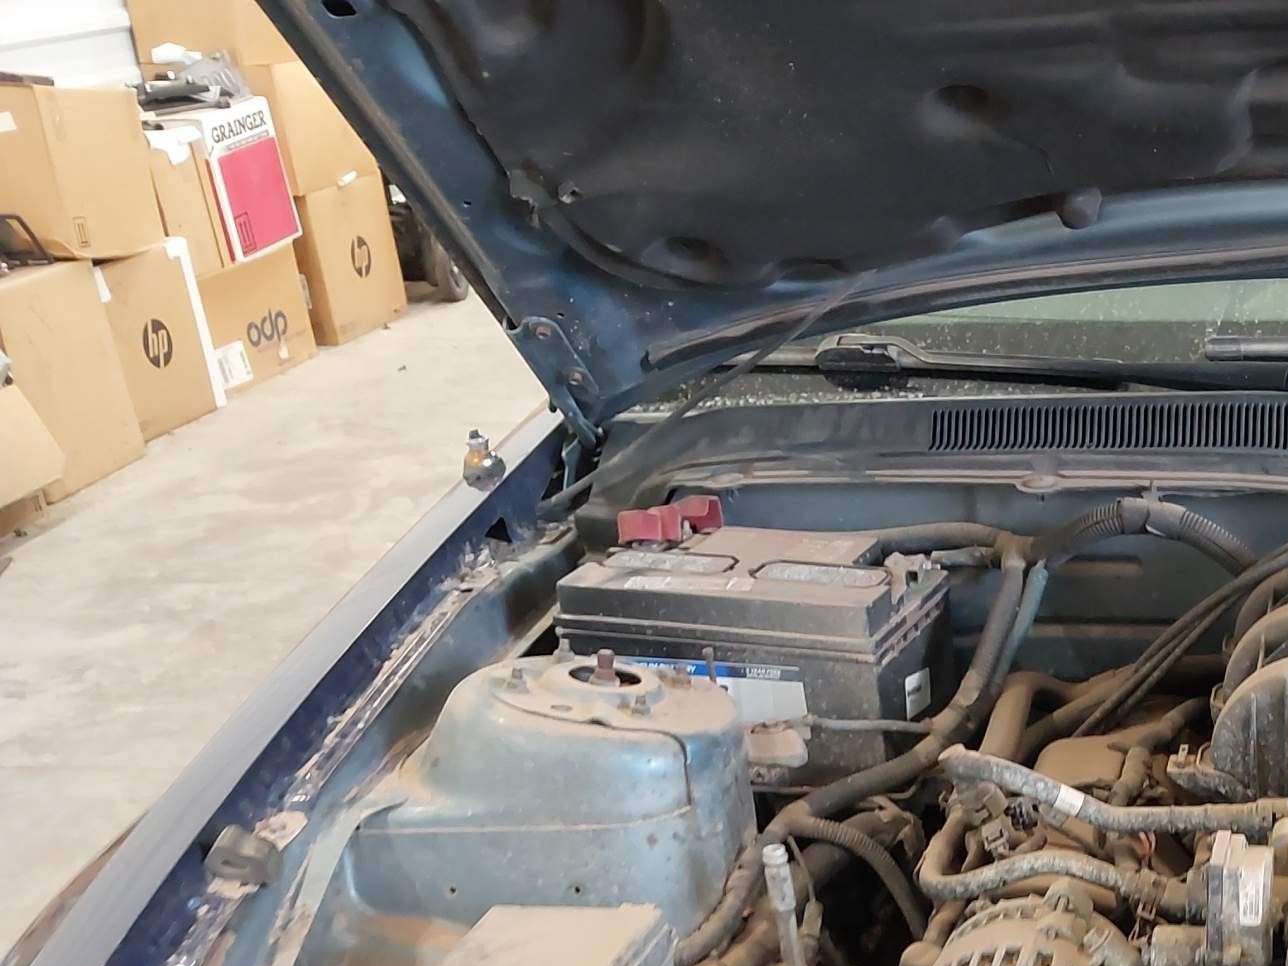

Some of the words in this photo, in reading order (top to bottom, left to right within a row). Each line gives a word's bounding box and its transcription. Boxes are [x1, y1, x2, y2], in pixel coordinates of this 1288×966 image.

[211, 110, 266, 143] GRAINGER
[352, 236, 371, 278] hp
[144, 318, 171, 368] hp
[247, 307, 287, 347] odp
